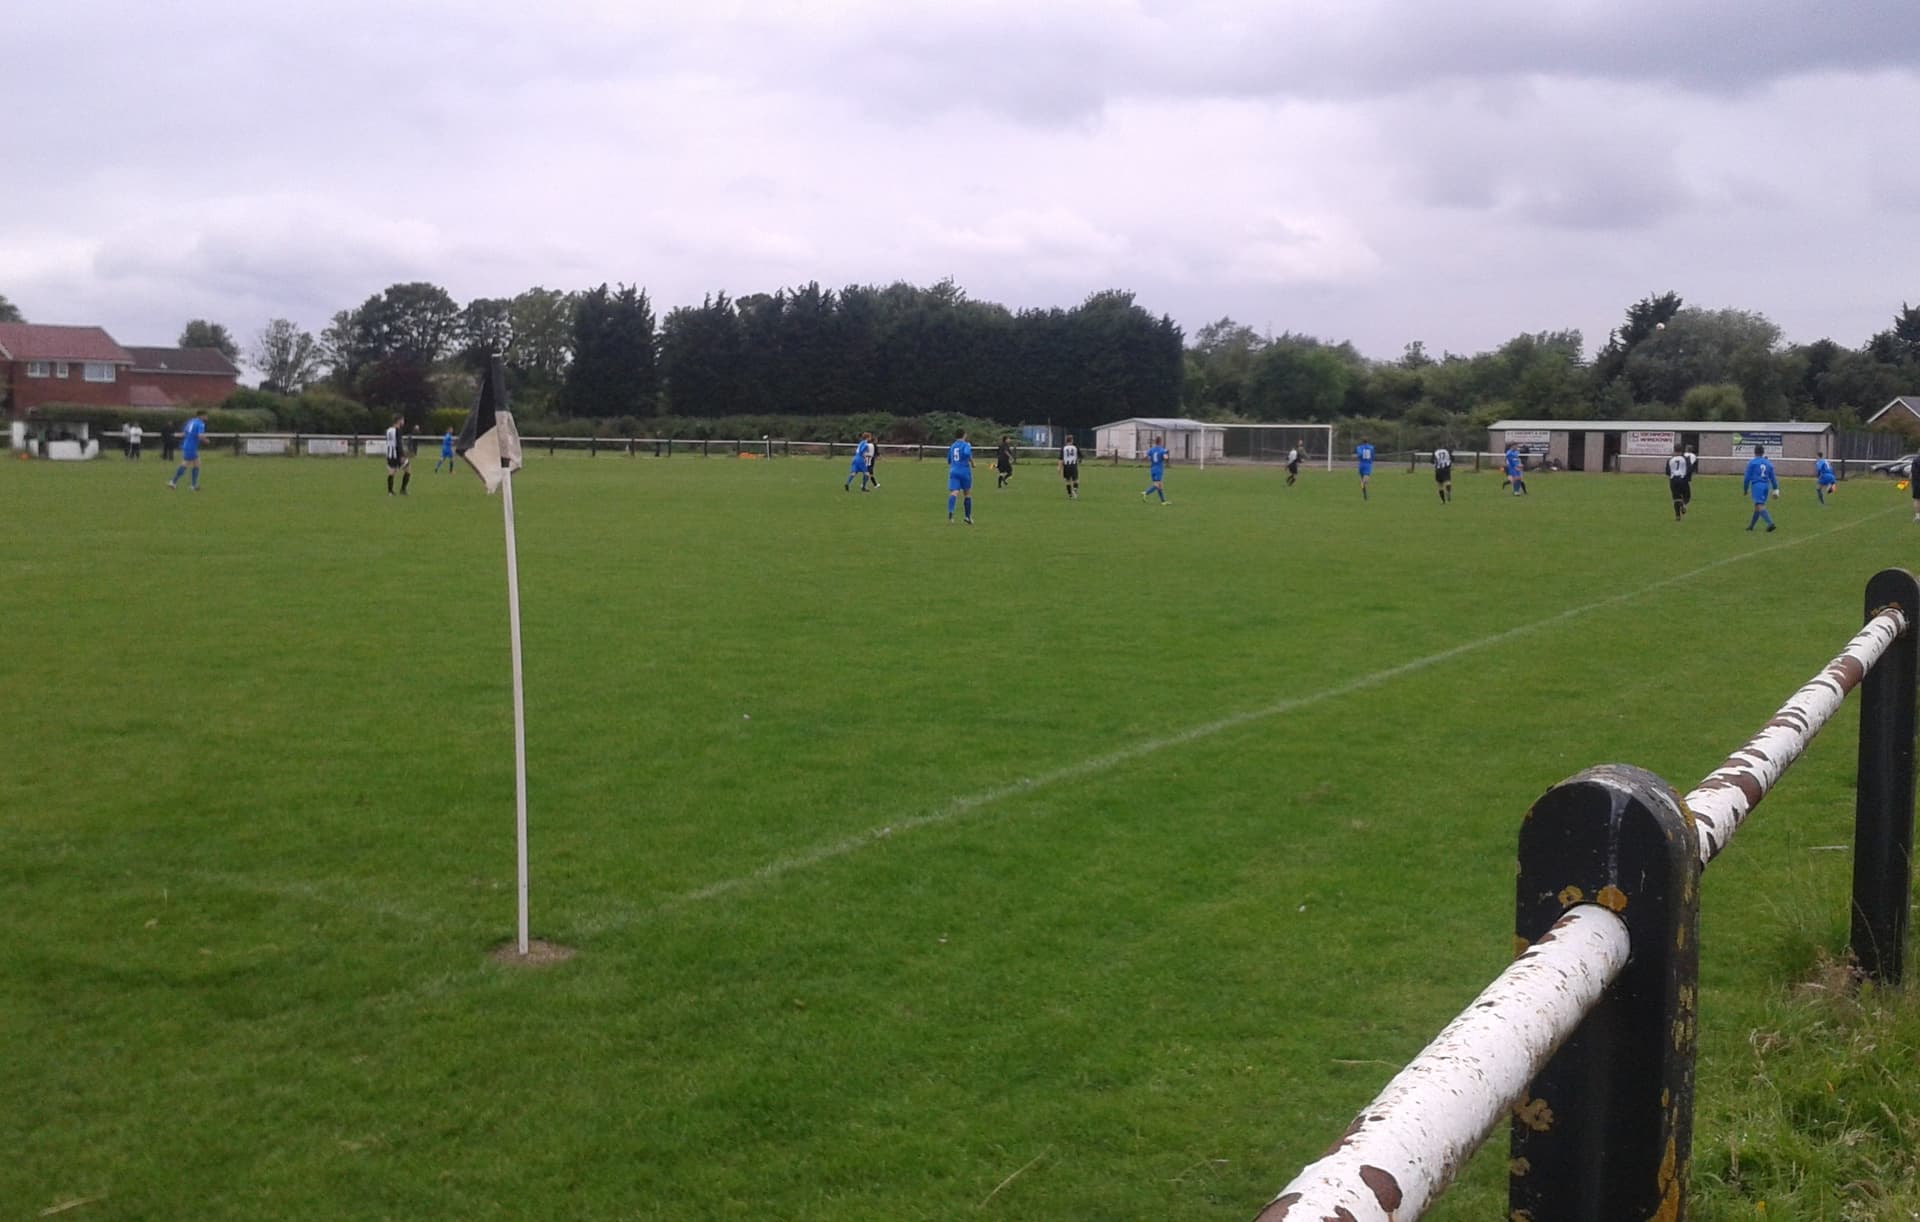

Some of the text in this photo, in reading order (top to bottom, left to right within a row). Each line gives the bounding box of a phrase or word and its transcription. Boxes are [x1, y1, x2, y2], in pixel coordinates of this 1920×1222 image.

[953, 447, 960, 461] 5
[1674, 460, 1681, 471] 7
[1759, 463, 1767, 478] 2
